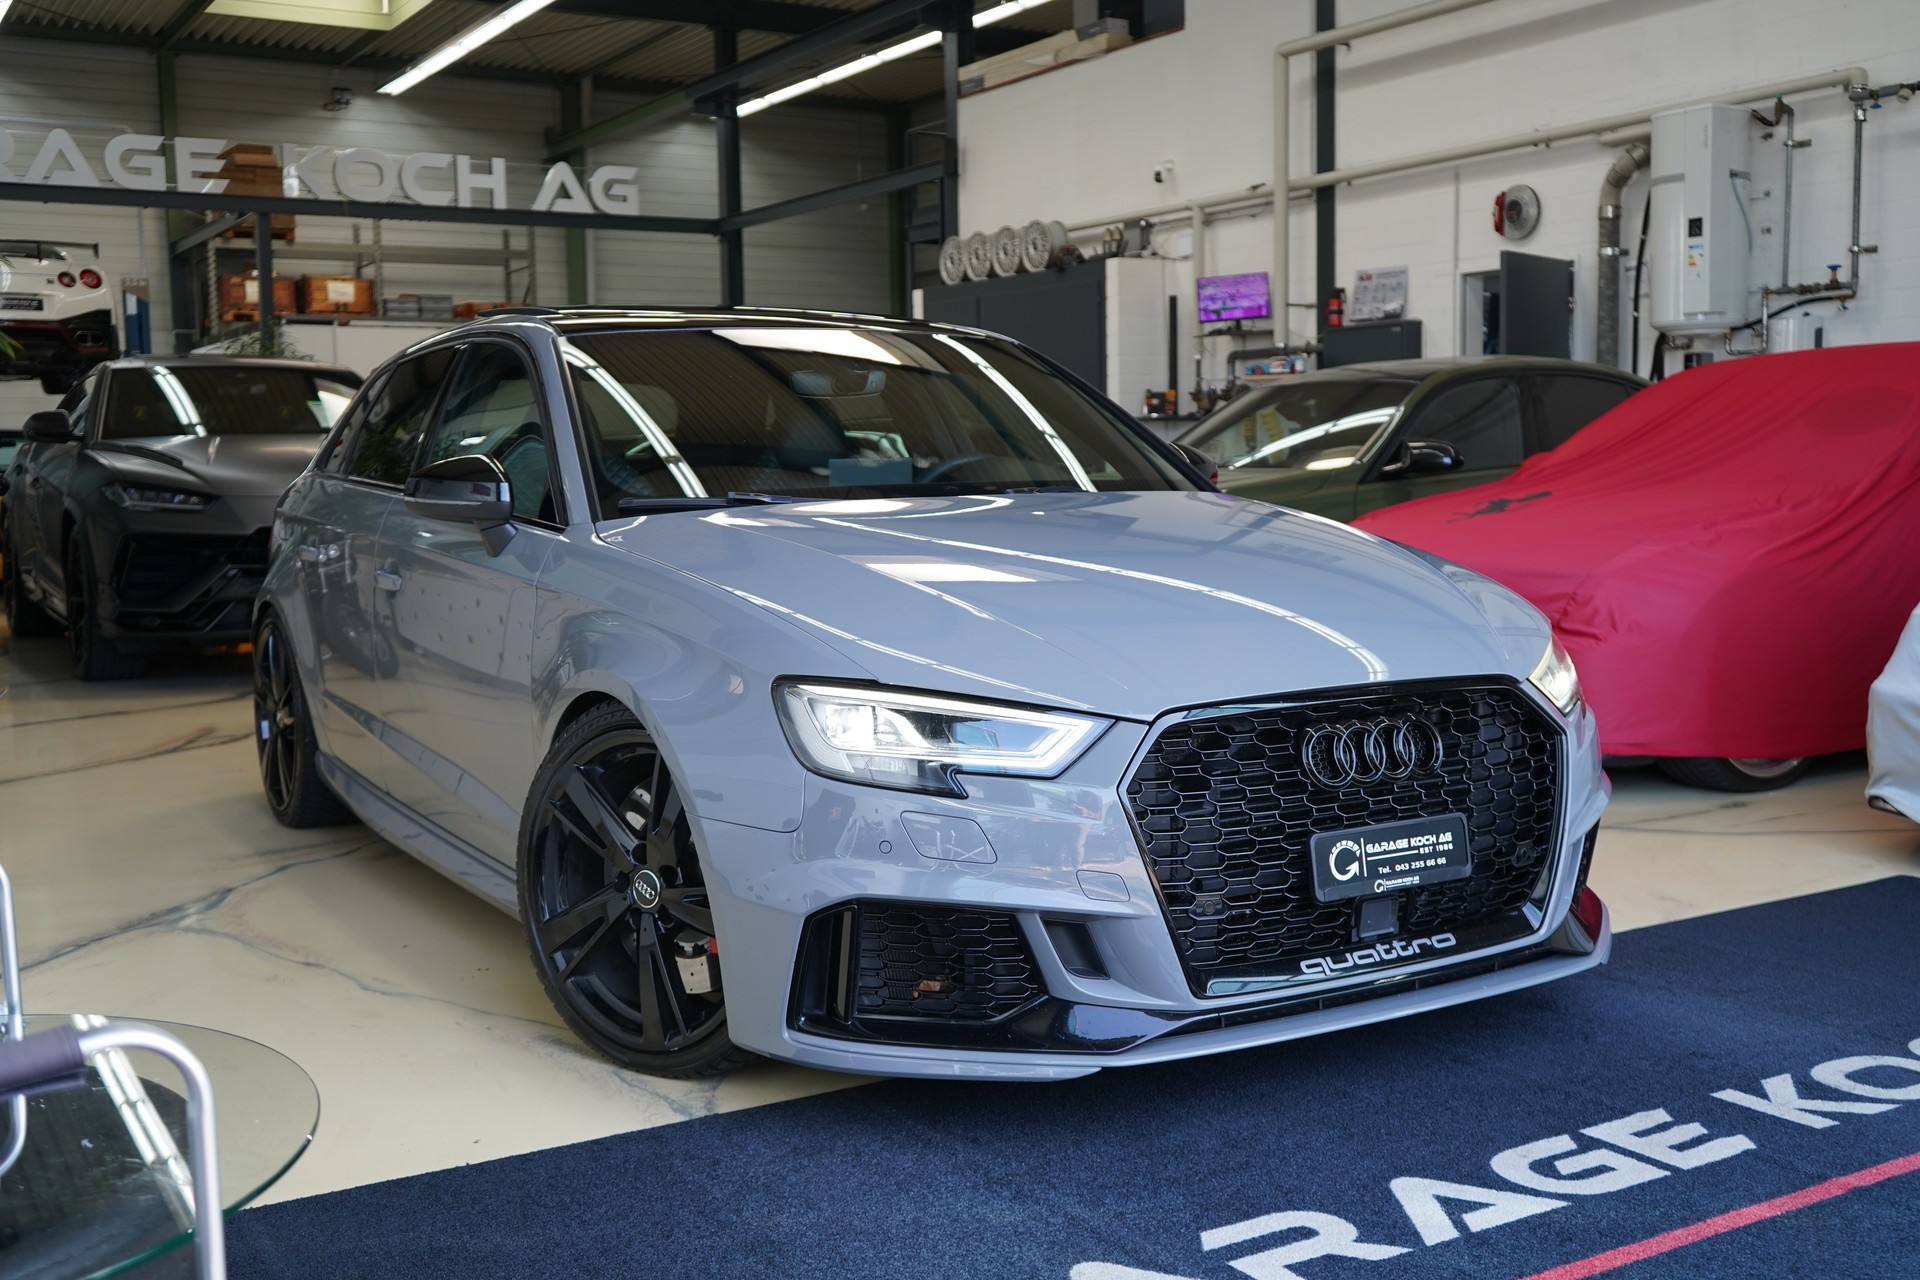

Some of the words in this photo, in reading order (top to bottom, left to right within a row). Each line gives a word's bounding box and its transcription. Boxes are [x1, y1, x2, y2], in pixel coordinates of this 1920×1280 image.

[0, 127, 231, 194] AGE
[282, 142, 508, 209] KOCH
[531, 161, 639, 215] AG
[1365, 838, 1409, 853] GARAGE
[1410, 834, 1437, 847] KOCH
[1438, 832, 1452, 843] AG
[1420, 846, 1433, 854] EST
[1378, 866, 1392, 874] Tel.
[1395, 863, 1409, 871] 043
[1411, 860, 1425, 869] 255
[1426, 858, 1436, 867] 66
[1300, 932, 1457, 976] quattro
[1710, 1037, 1920, 1129] KO
